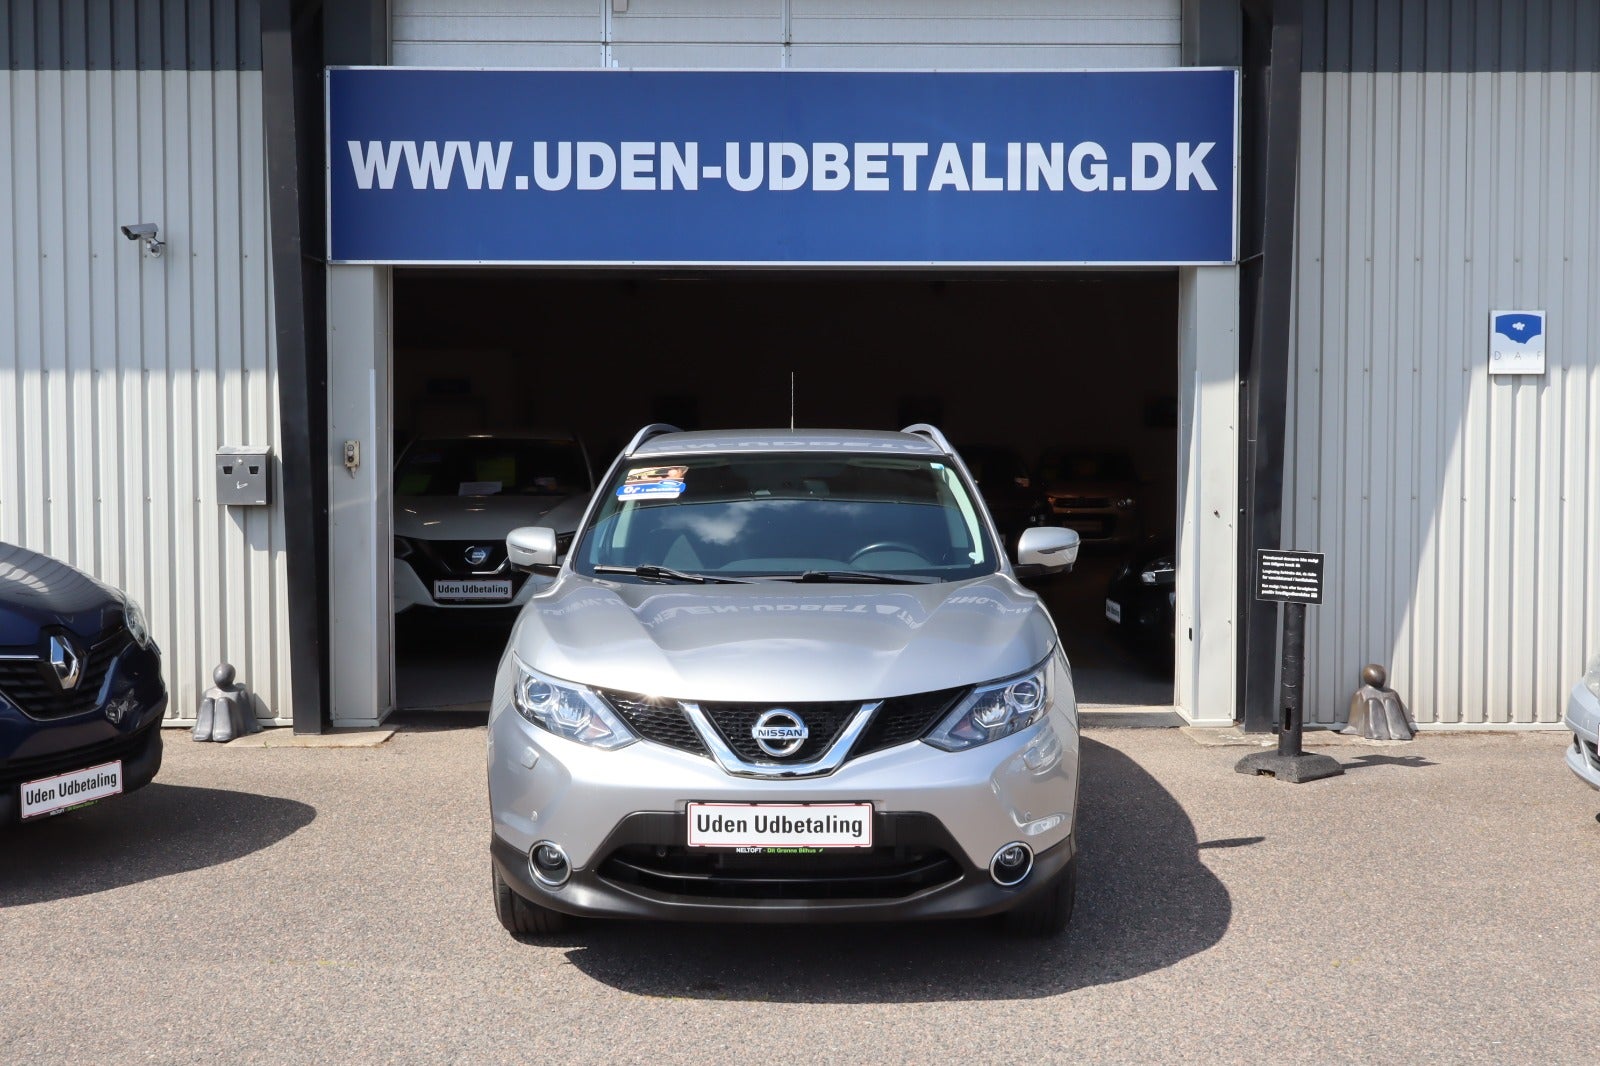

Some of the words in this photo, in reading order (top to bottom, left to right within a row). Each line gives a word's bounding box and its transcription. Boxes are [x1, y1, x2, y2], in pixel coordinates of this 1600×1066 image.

[347, 140, 1218, 193] WWW.UDEN-UDBETALING.DK
[438, 585, 460, 593] Uden
[462, 585, 509, 595] Udbetaling
[758, 729, 802, 737] NISSAN
[26, 788, 55, 806] Uden
[59, 773, 117, 798] Udbetaling
[697, 814, 747, 833] Uden
[754, 815, 863, 838] Udbetaling
